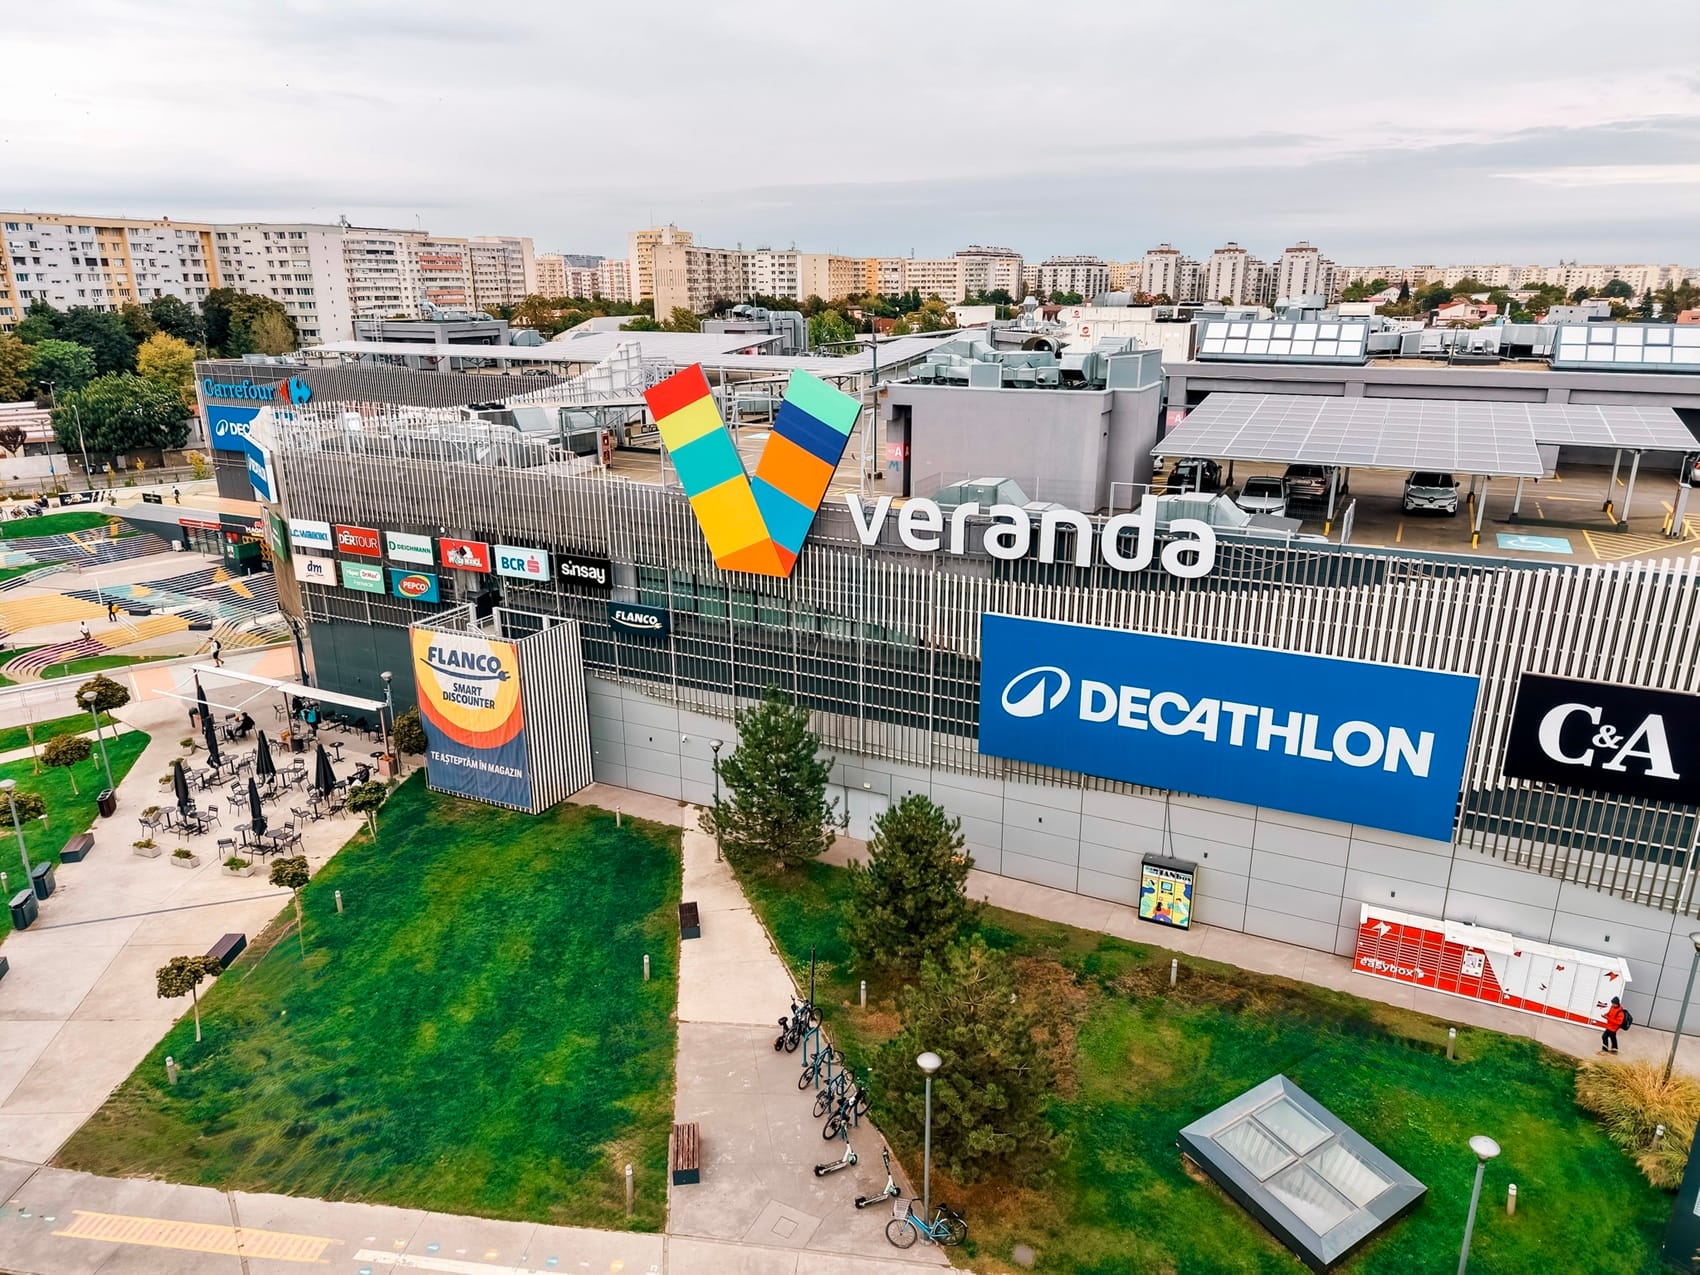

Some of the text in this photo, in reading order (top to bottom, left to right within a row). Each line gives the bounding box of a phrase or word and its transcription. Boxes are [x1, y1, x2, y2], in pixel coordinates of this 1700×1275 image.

[203, 378, 275, 400] Carrefour
[339, 532, 378, 548] DERTOUR
[845, 493, 1217, 578] veranda
[397, 544, 431, 554] DEICHMANN
[307, 560, 322, 573] dm
[501, 556, 525, 571] BCR
[561, 560, 606, 584] sinsay
[402, 581, 426, 591] PEPCO
[615, 610, 658, 626] FLANCO
[428, 646, 502, 673] FLANCO
[453, 682, 482, 696] SMART
[442, 691, 495, 709] DISCOUNTER
[1078, 679, 1435, 778] DECATHLON
[1537, 701, 1681, 780] C&A
[431, 751, 440, 761] TE
[488, 764, 522, 778] MAGAZIN
[1360, 958, 1414, 976] easybox
